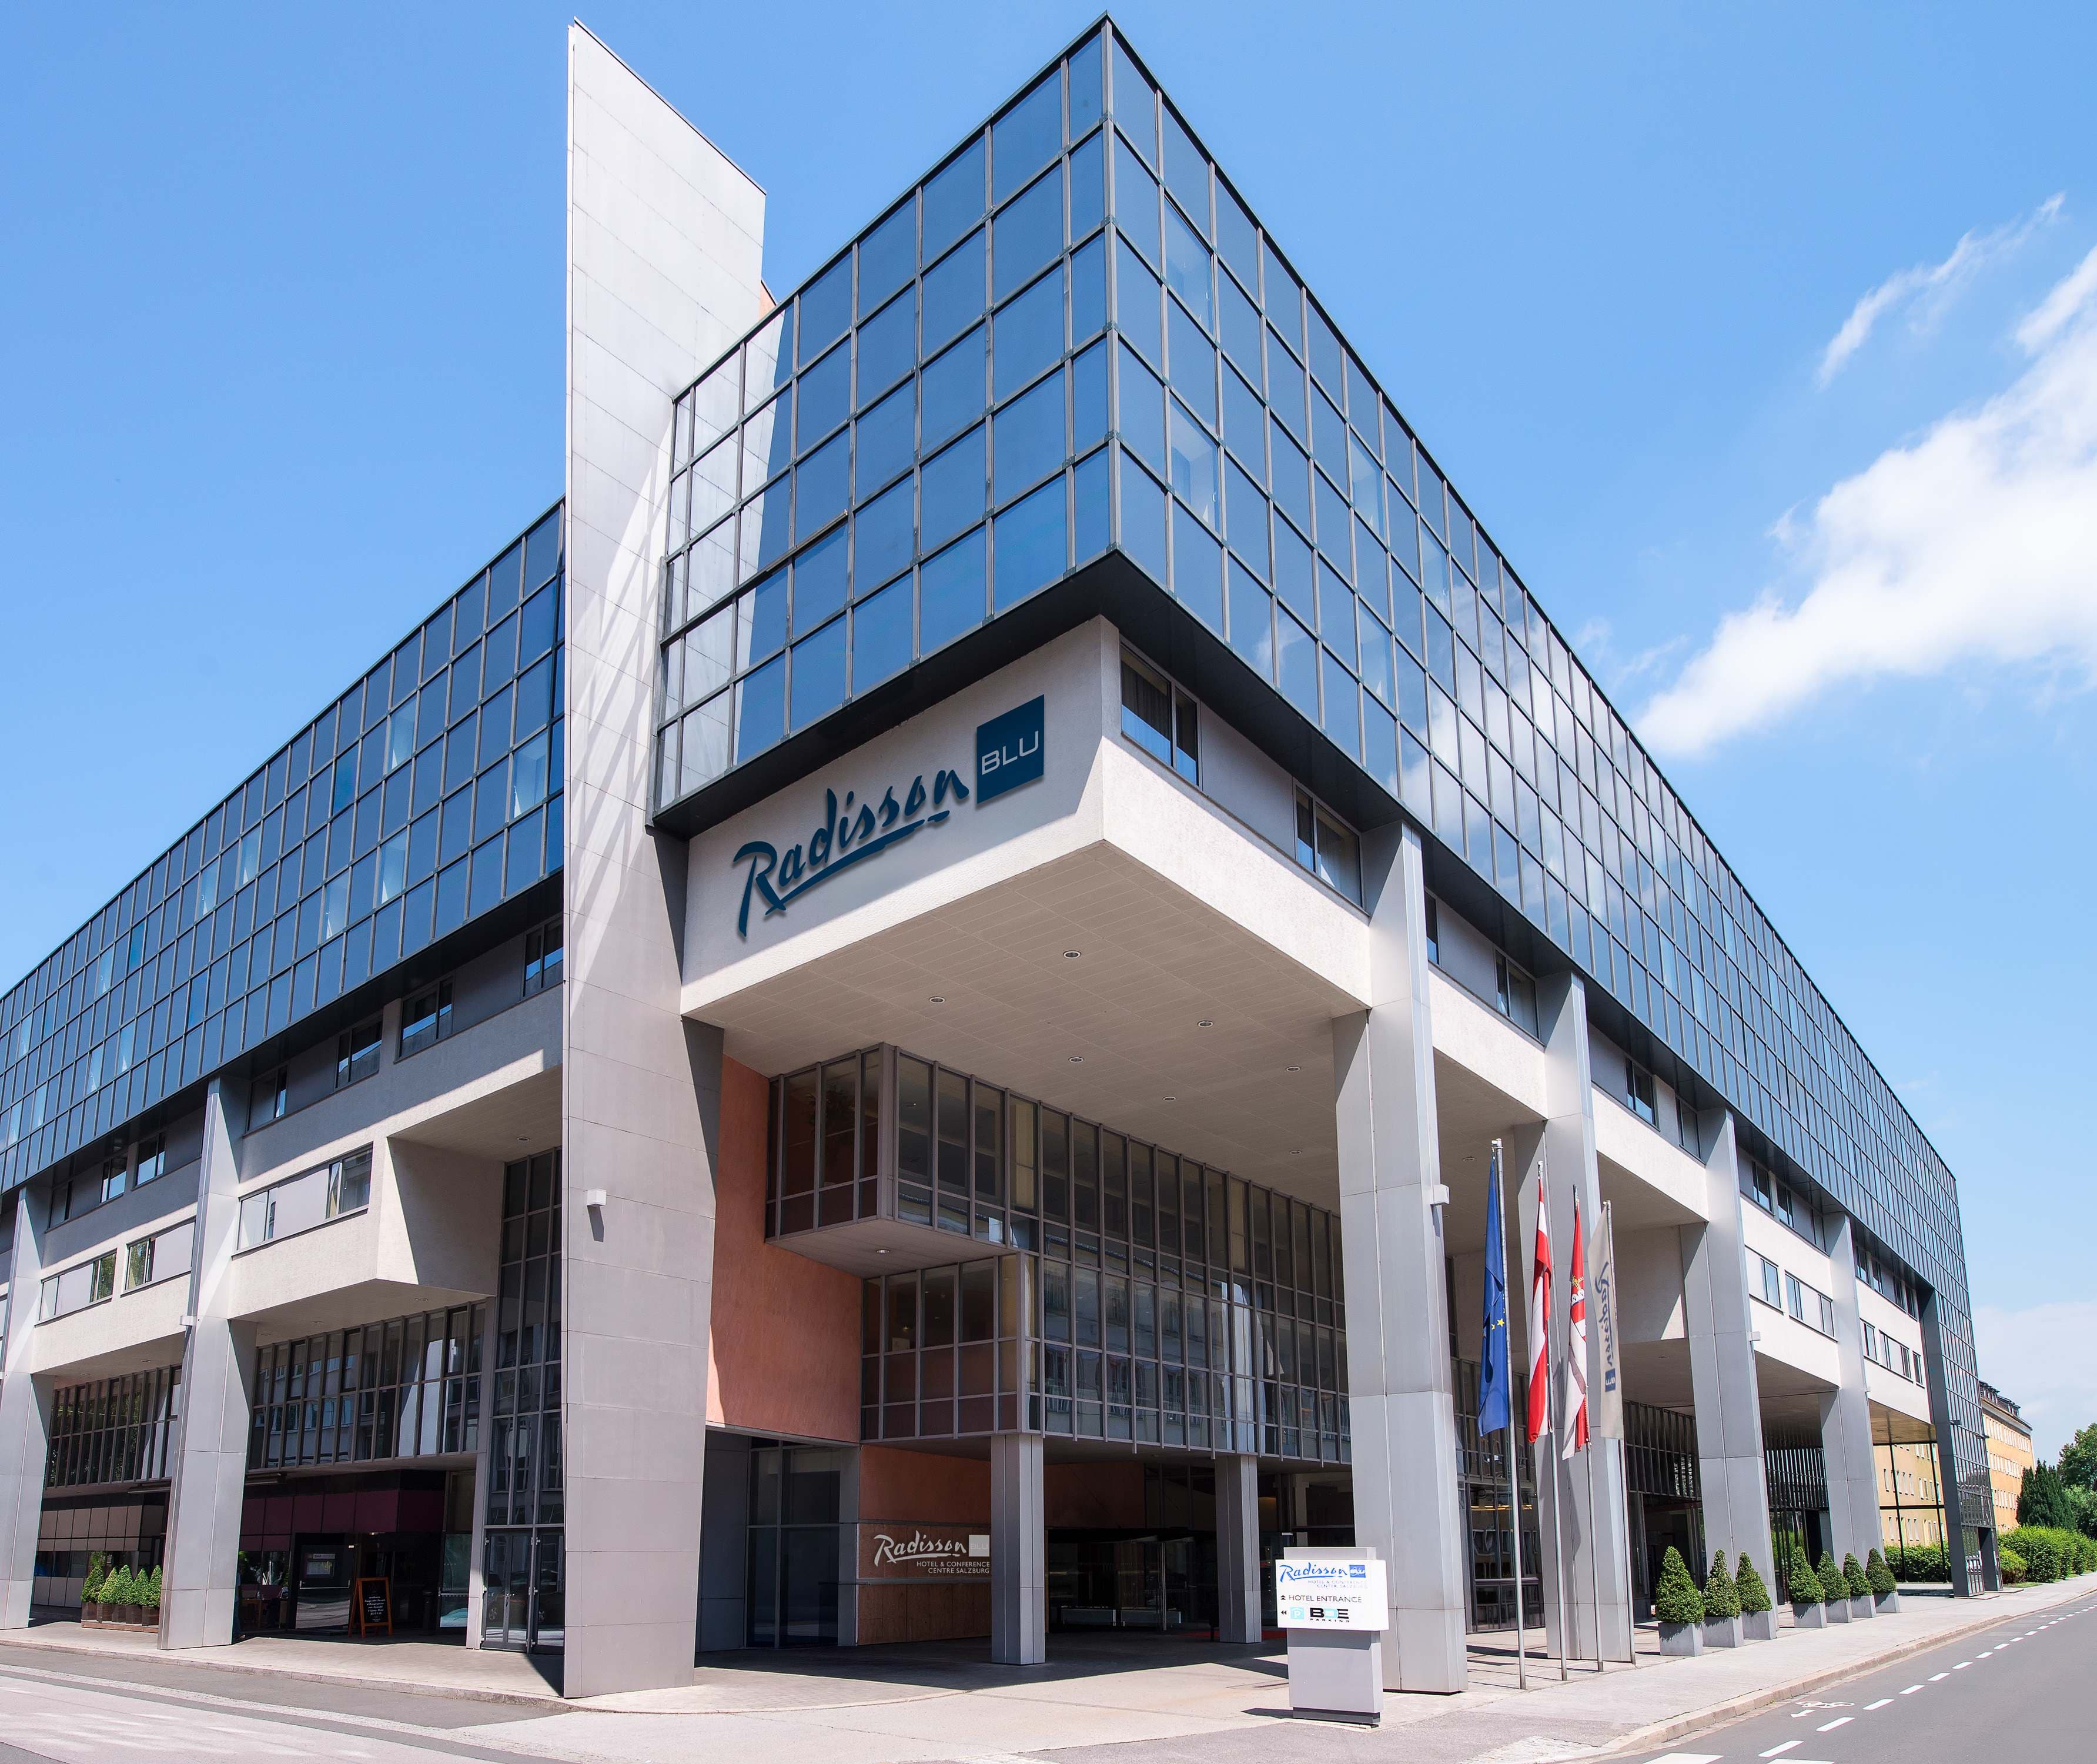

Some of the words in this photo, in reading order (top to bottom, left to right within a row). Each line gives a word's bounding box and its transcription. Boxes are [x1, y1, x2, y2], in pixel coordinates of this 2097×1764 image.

[733, 770, 969, 937] Radisson
[981, 730, 1039, 775] BLU
[874, 1530, 966, 1567] Radisson
[1279, 1562, 1347, 1583] Radisson
